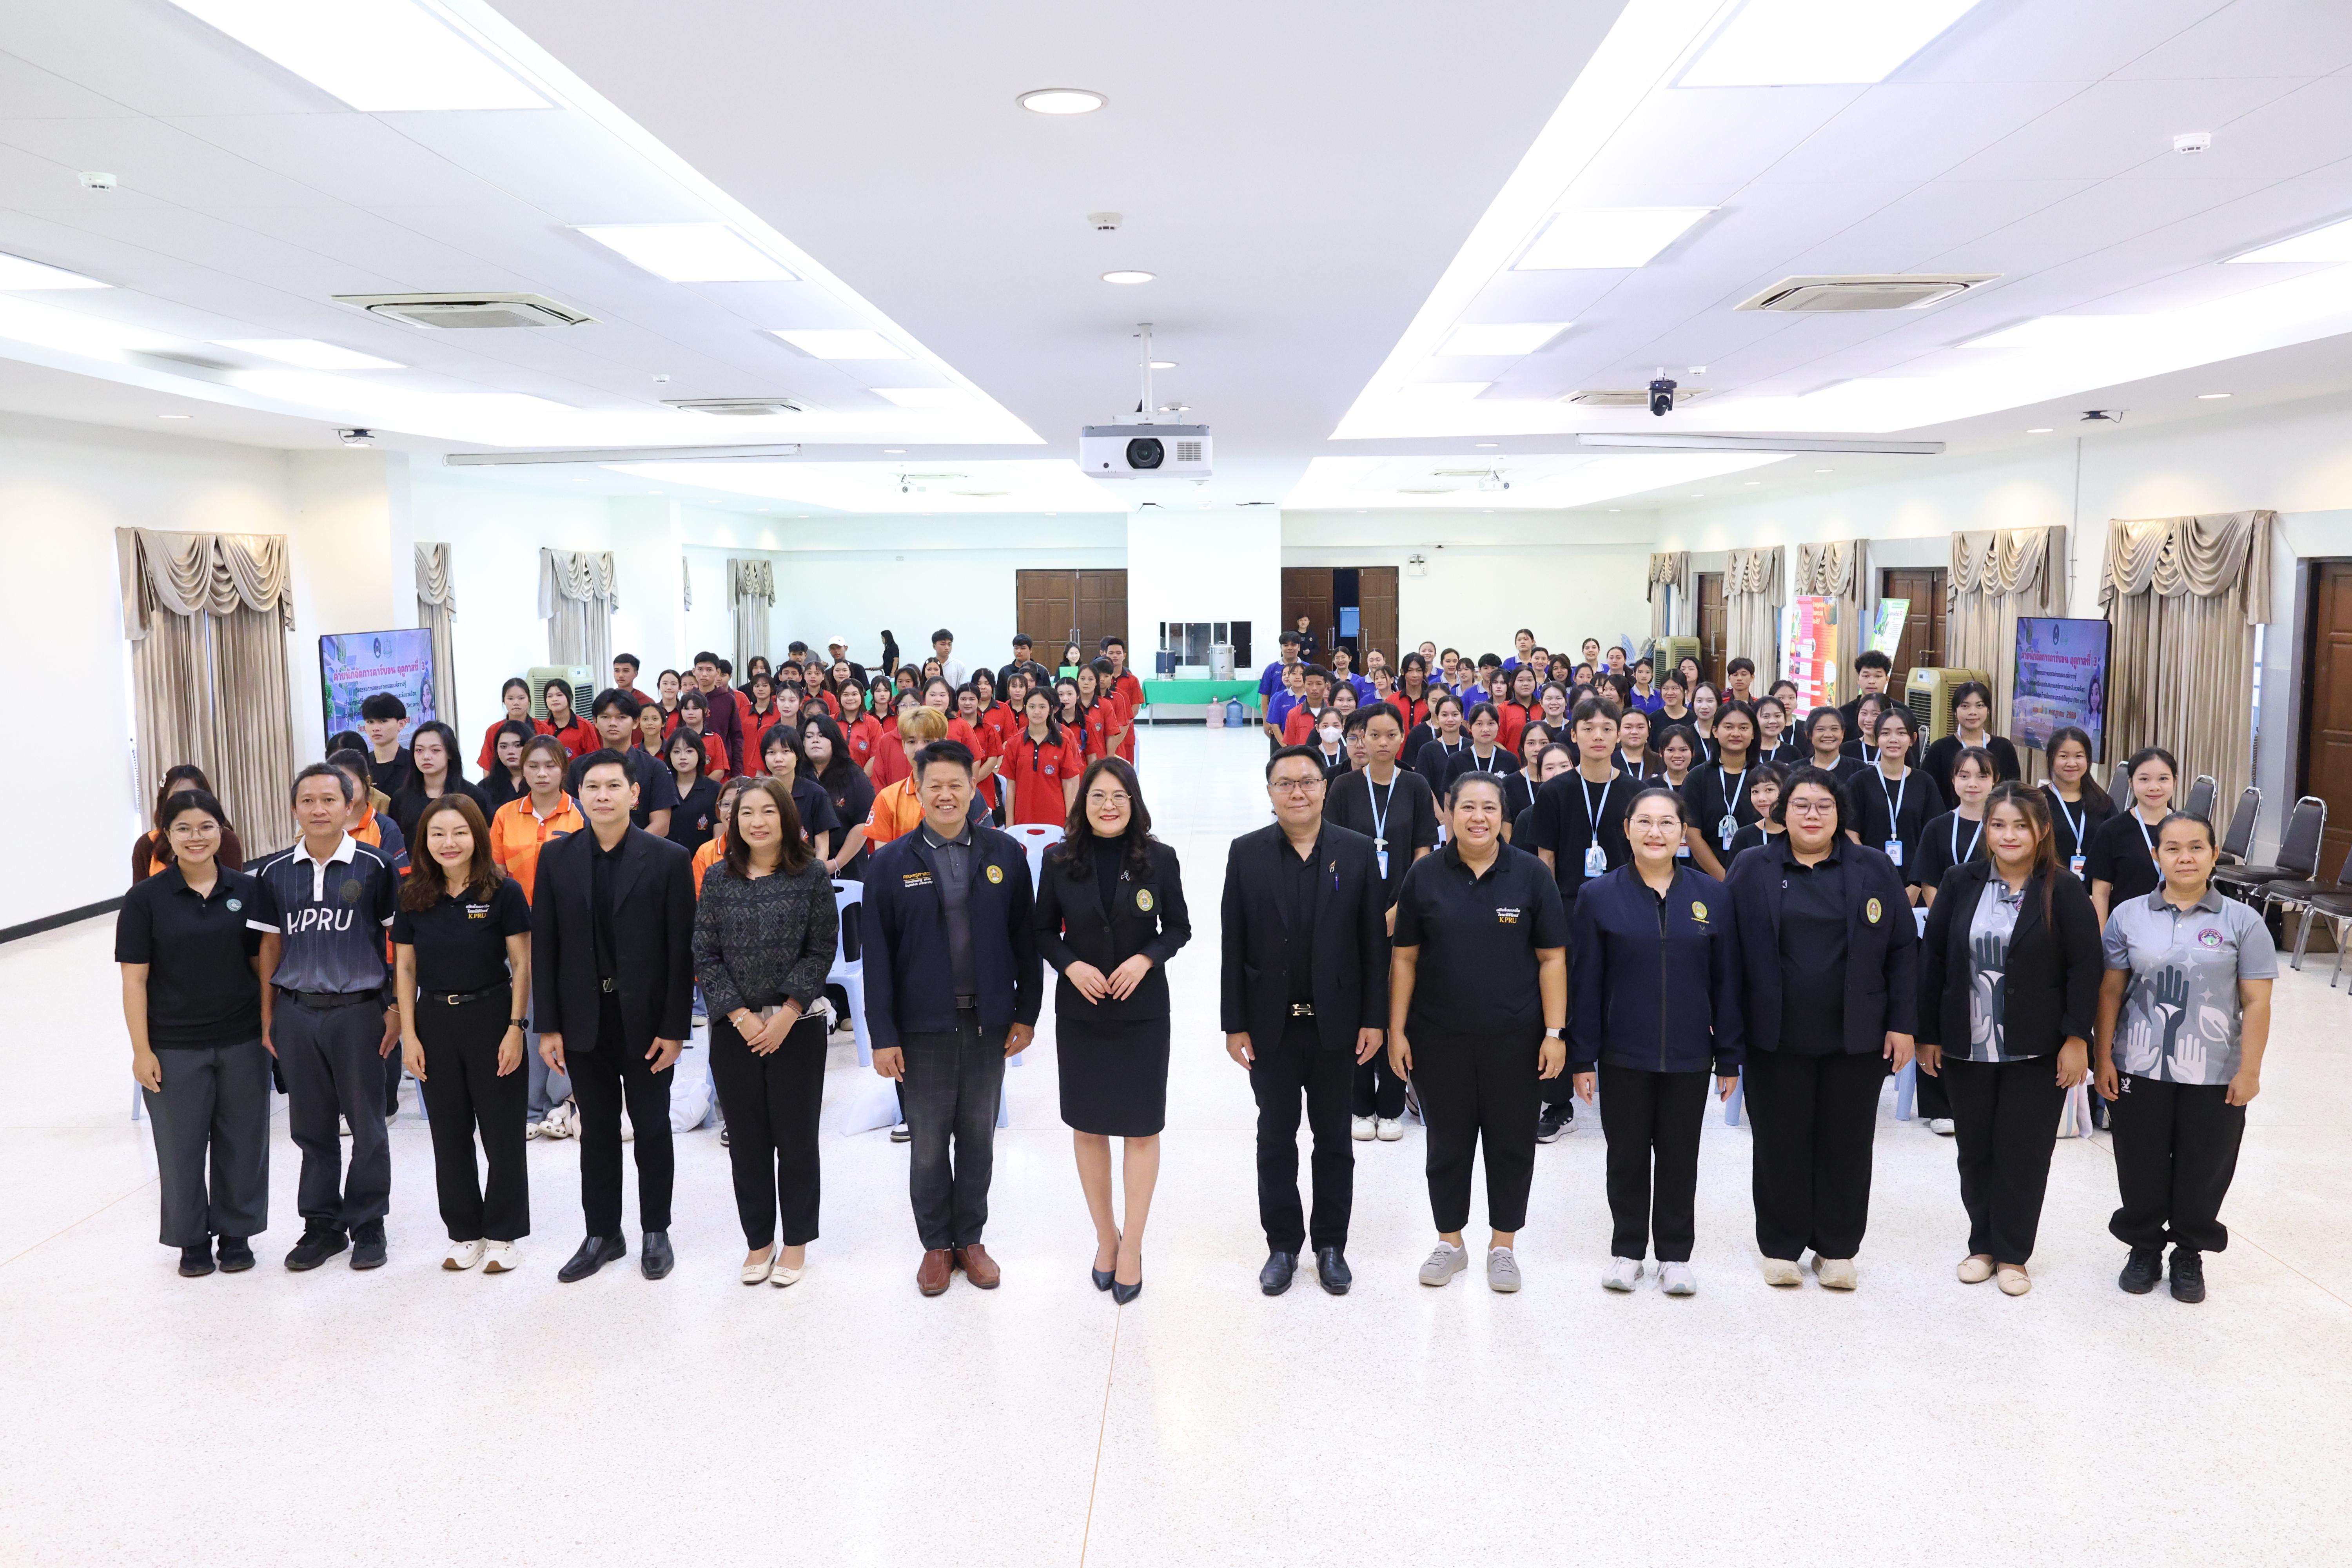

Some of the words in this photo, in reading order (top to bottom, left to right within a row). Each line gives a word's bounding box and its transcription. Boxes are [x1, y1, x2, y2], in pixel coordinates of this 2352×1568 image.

[334, 664, 396, 681] ค่ายนักจัดการคาร์บอน
[397, 656, 419, 677] ฤดูกาลที่
[421, 662, 425, 671] 3
[2093, 657, 2097, 666] 3
